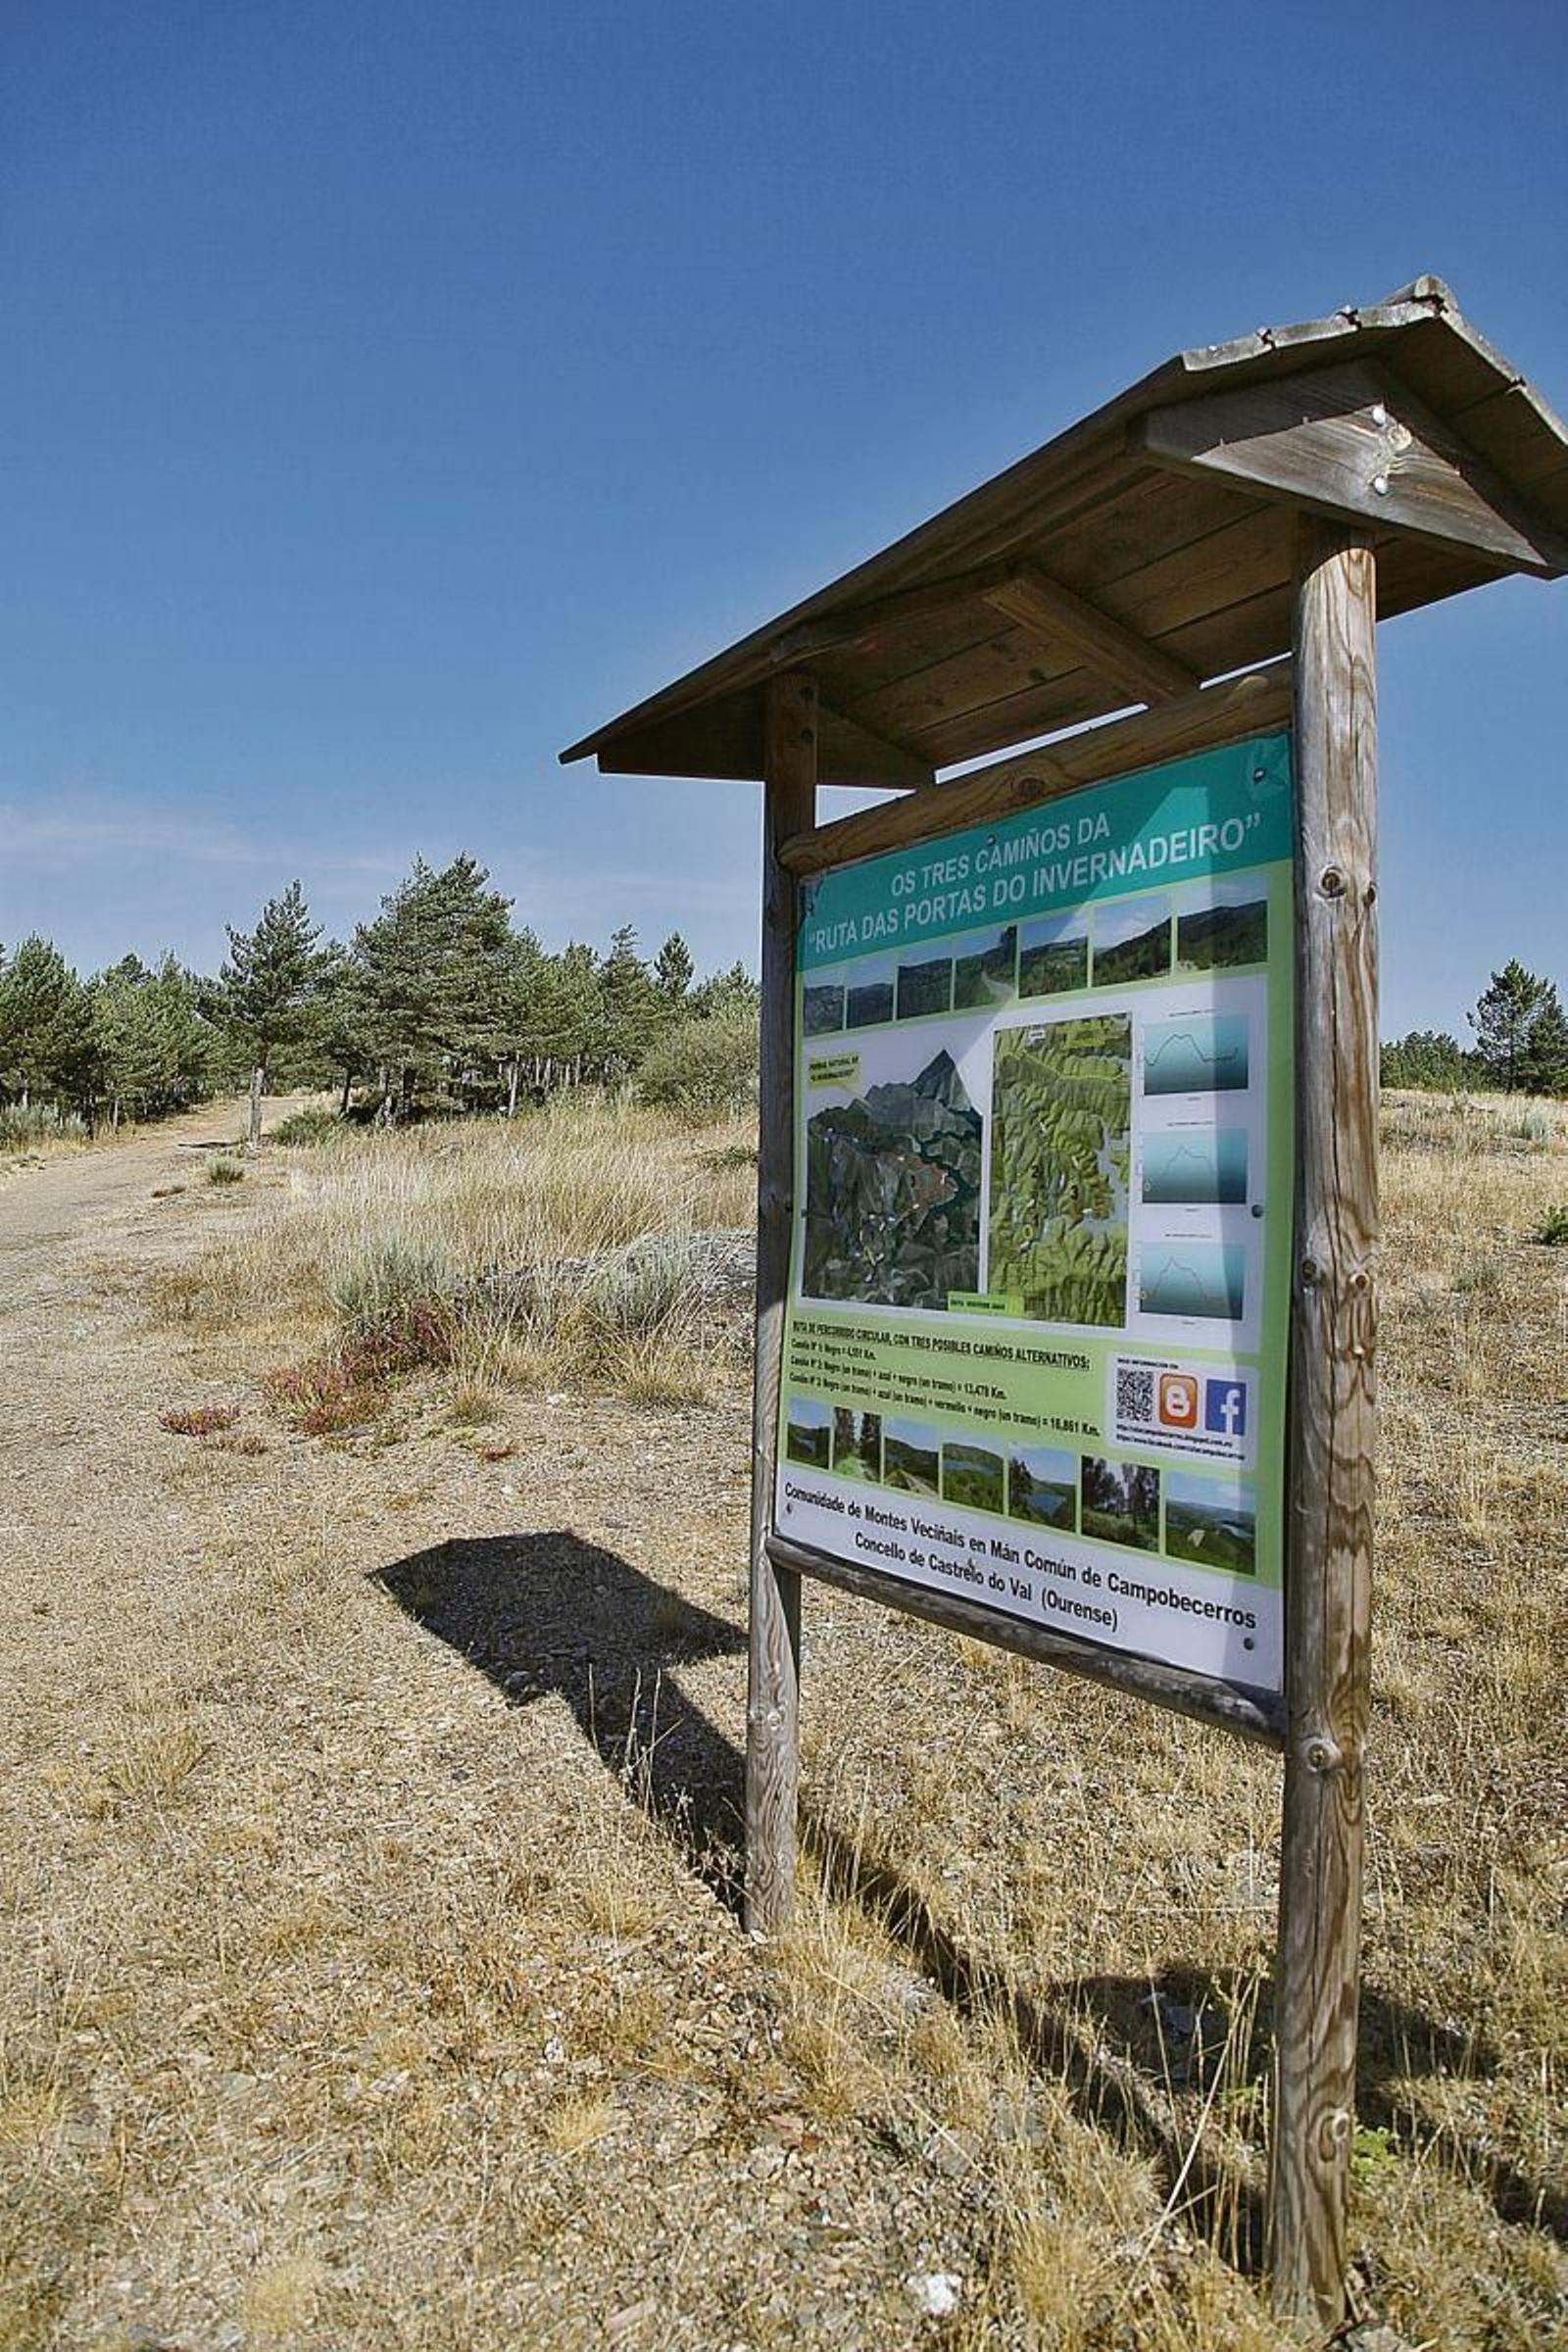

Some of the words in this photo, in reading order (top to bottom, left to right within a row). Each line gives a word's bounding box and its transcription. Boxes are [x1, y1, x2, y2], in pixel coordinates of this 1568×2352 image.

[891, 871, 916, 897] OS
[922, 855, 968, 888] TRES
[975, 823, 1070, 873] CAMIÑOS
[1078, 812, 1110, 845] DA
[861, 907, 899, 941] DAS
[905, 884, 987, 930] PORTAS
[993, 874, 1026, 906] DO
[894, 1333, 909, 1347] CON
[911, 1335, 930, 1349] TRES
[932, 1338, 971, 1354] POSIBLES
[973, 1342, 1013, 1360] CAMIÑOS
[1015, 1348, 1090, 1371] ALTERNATIVOS:
[973, 1407, 996, 1420] negro
[1013, 1412, 1041, 1429] tramo)
[1082, 1423, 1101, 1438] Km.
[991, 1386, 1006, 1399] Km.
[785, 1482, 845, 1514] Comunidade
[848, 1501, 861, 1518] de
[865, 1504, 906, 1532] Montes
[969, 1537, 986, 1554] en
[1024, 1549, 1076, 1581] Común
[1082, 1566, 1102, 1588] de
[1108, 1573, 1256, 1629] Campobecerros
[856, 1532, 906, 1561] Concello
[909, 1547, 925, 1566] de
[929, 1553, 984, 1585] Castrelo
[989, 1571, 1005, 1592] do
[1010, 1577, 1031, 1601] Val
[1042, 1587, 1118, 1633] (Ourense)
